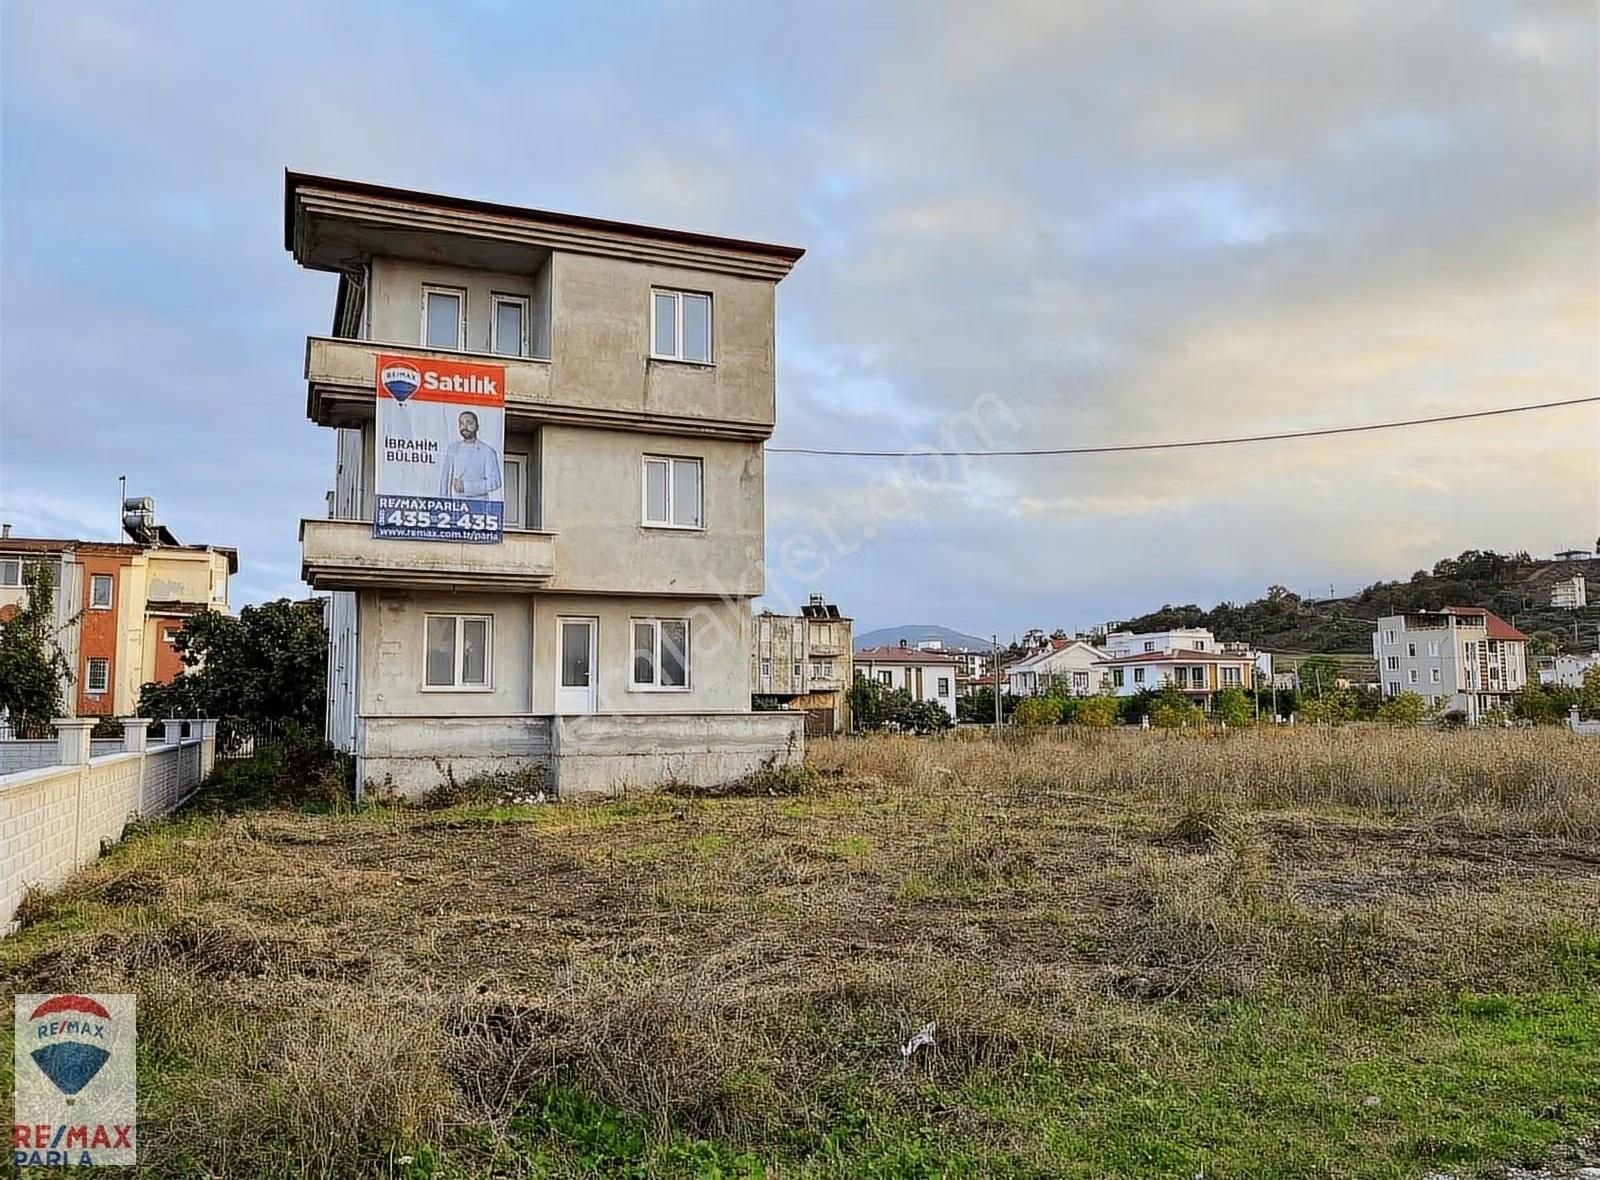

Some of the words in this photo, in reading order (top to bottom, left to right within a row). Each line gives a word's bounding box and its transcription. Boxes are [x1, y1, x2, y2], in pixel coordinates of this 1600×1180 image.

[424, 371, 497, 395] Satılık
[384, 436, 438, 451] İBRAHİM
[386, 450, 436, 464] BÜLBÜL
[387, 510, 431, 527] 435
[436, 514, 451, 529] 2
[456, 514, 499, 531] 435
[379, 528, 499, 541] www.remax.com.tr/parla
